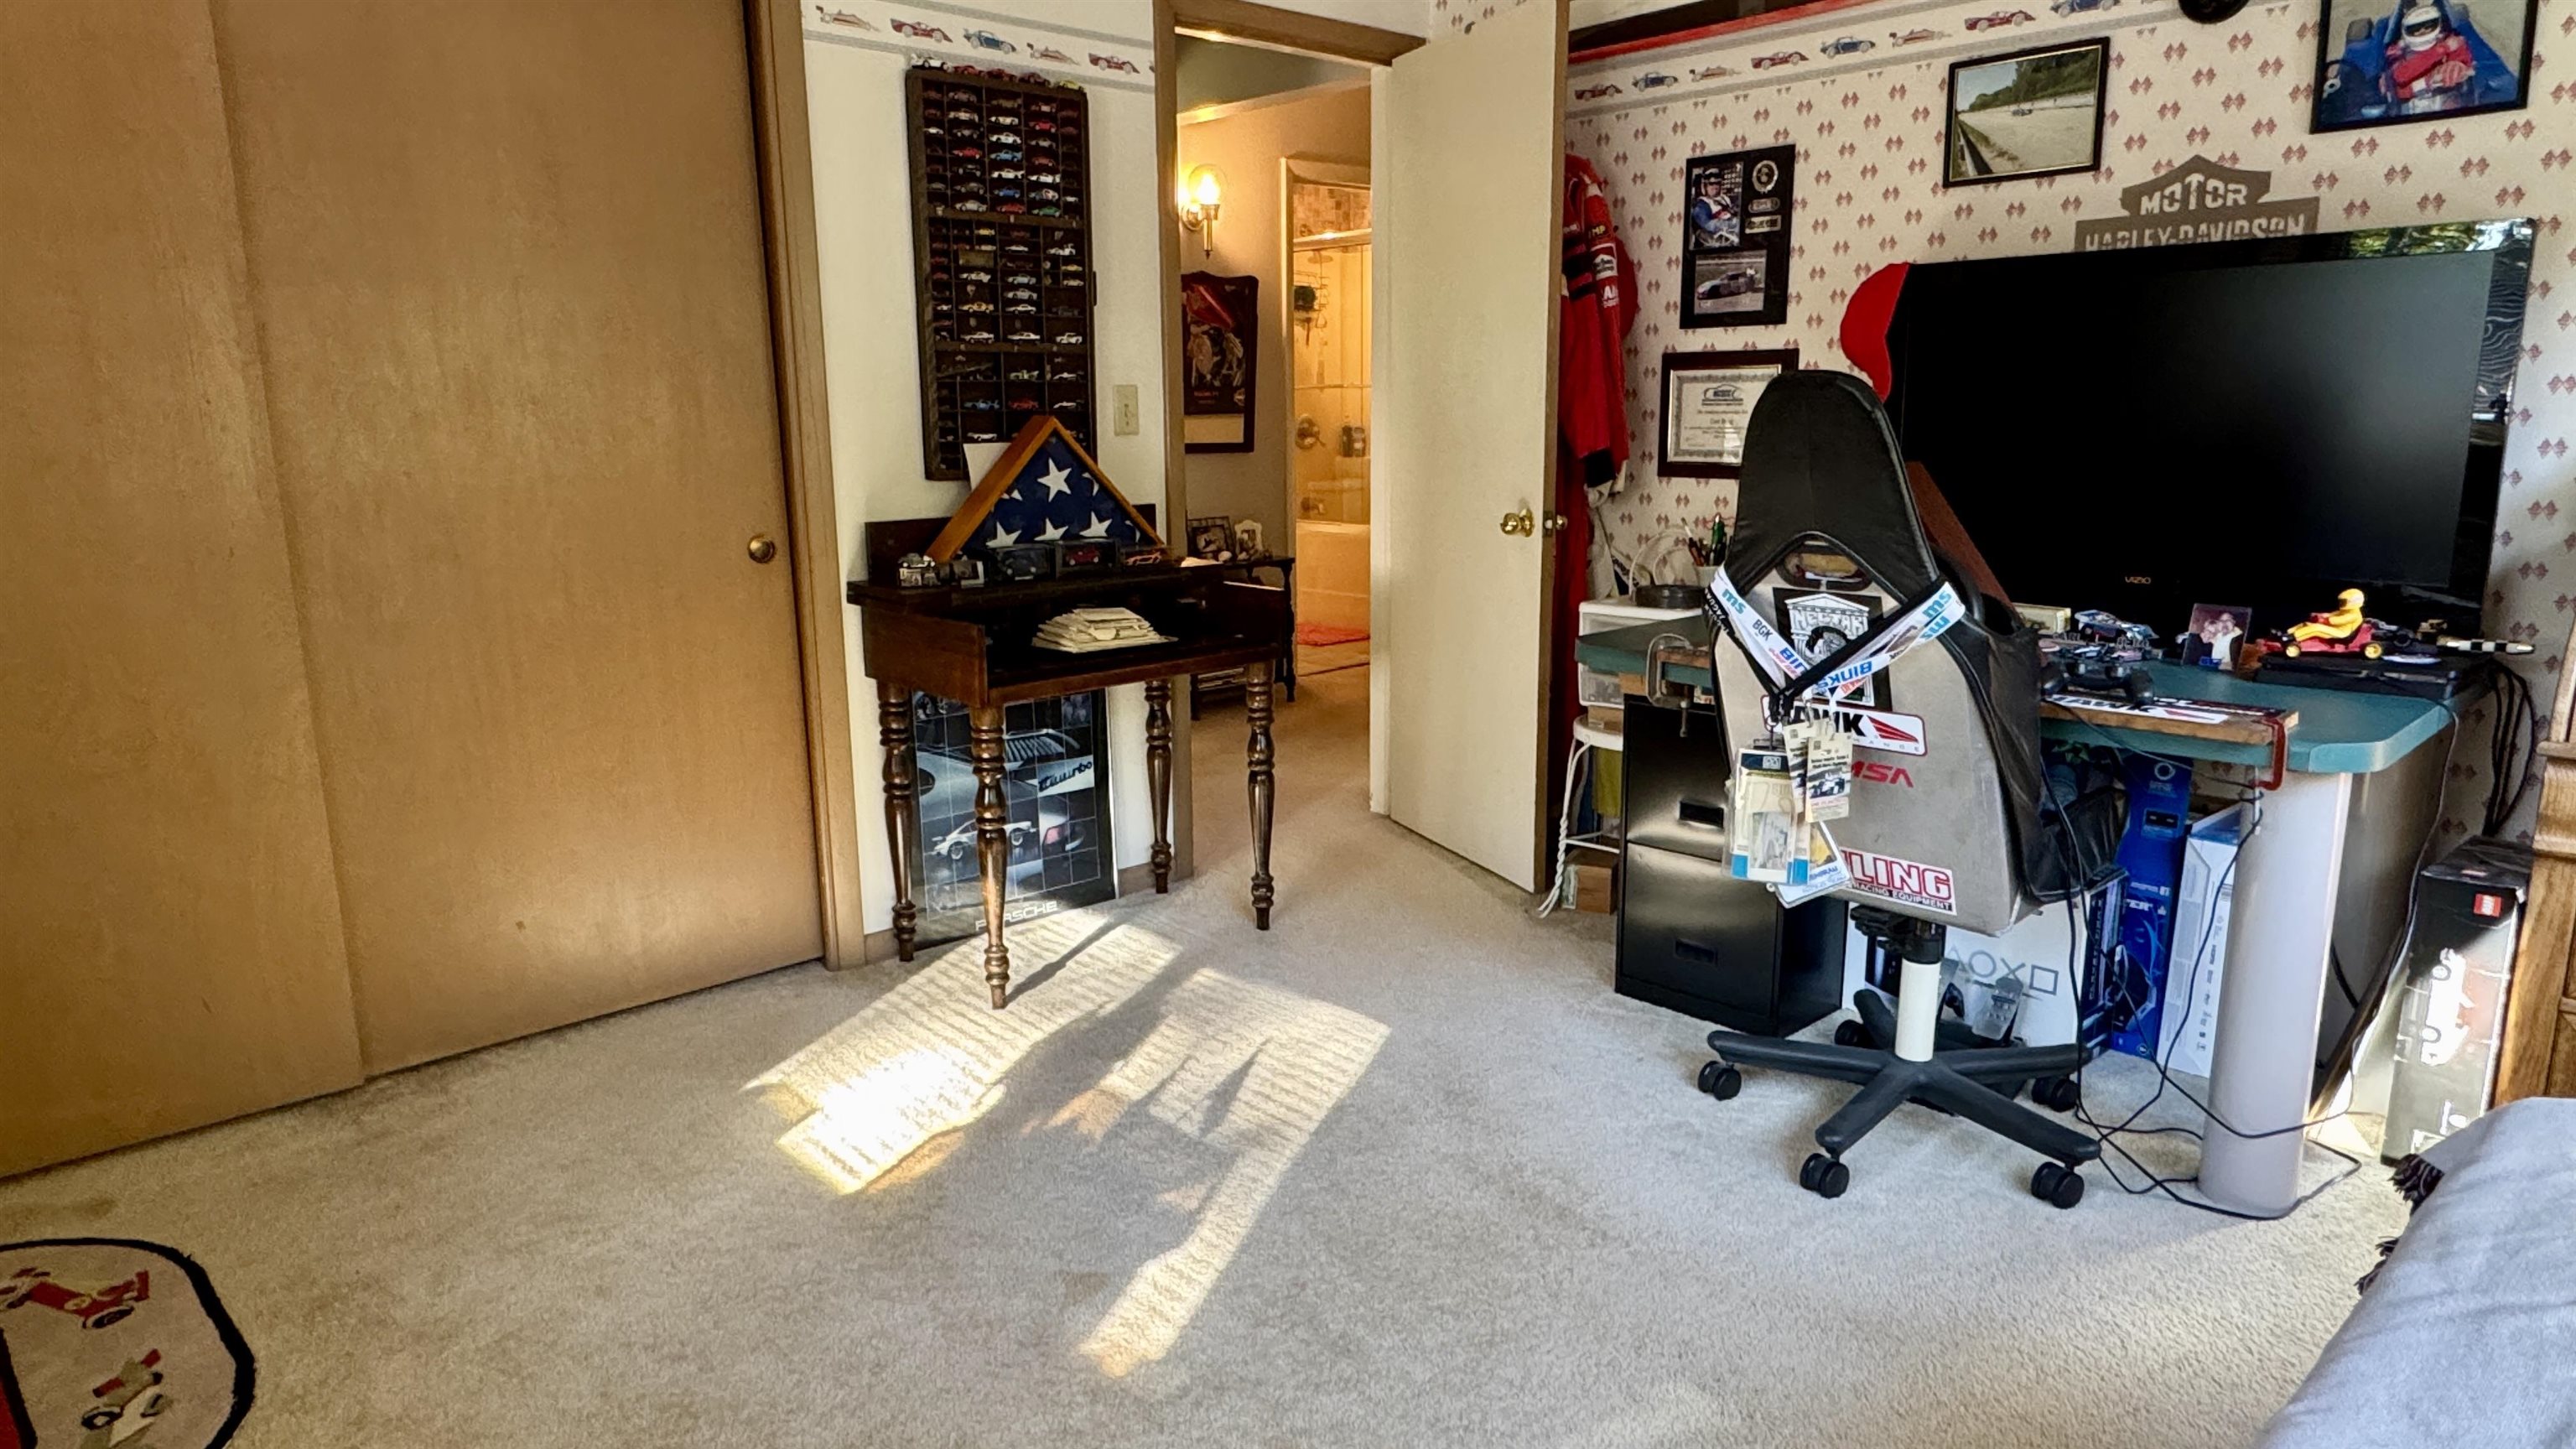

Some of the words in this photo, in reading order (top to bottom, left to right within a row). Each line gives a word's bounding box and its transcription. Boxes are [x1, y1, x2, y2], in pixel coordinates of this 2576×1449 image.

[2140, 173, 2248, 216] MOTOR
[1751, 619, 1774, 641] BGK
[1892, 890, 1951, 910] EQUIPMENT
